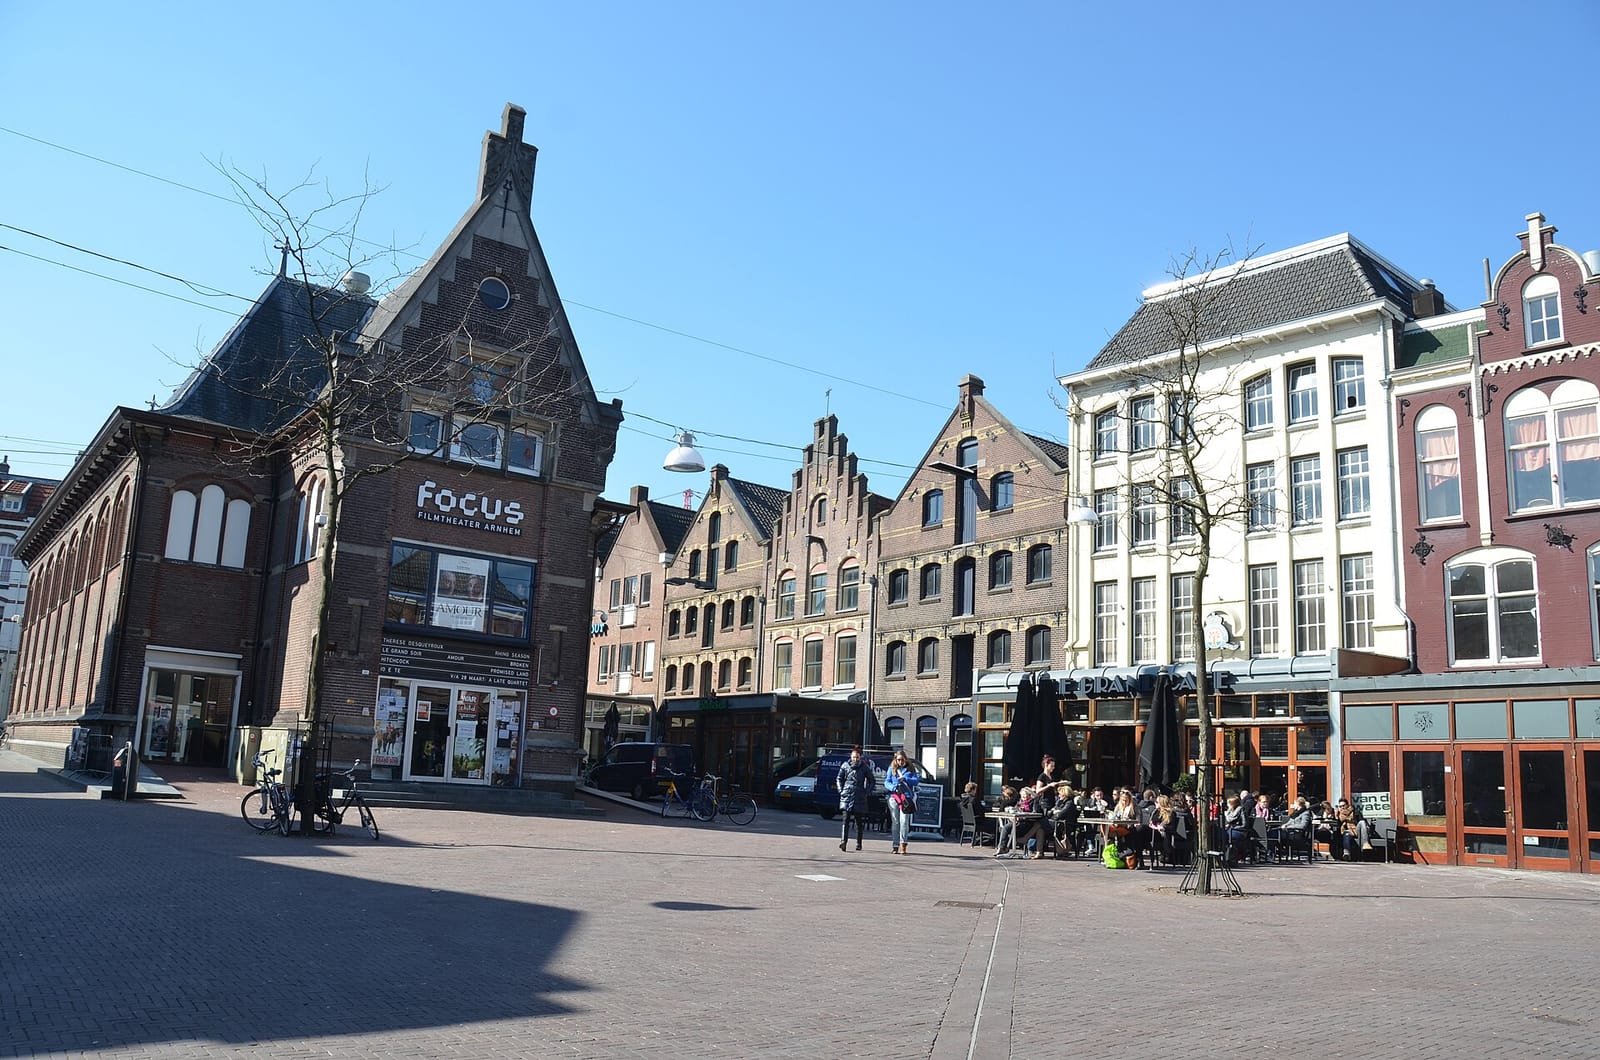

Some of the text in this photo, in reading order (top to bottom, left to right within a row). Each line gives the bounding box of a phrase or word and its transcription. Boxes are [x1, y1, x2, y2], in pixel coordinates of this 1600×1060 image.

[417, 480, 525, 524] FOCUS
[417, 511, 521, 536] FILMTHEATER ARNHEM
[437, 603, 483, 618] AMOUR
[380, 656, 410, 665] HITCHCOCK
[511, 652, 530, 660] SEASON
[509, 661, 529, 669] BROKEN
[490, 668, 515, 677] PROMISED
[1078, 674, 1143, 695] GRAN
[1168, 670, 1229, 692] CAE
[1352, 795, 1377, 803] van
